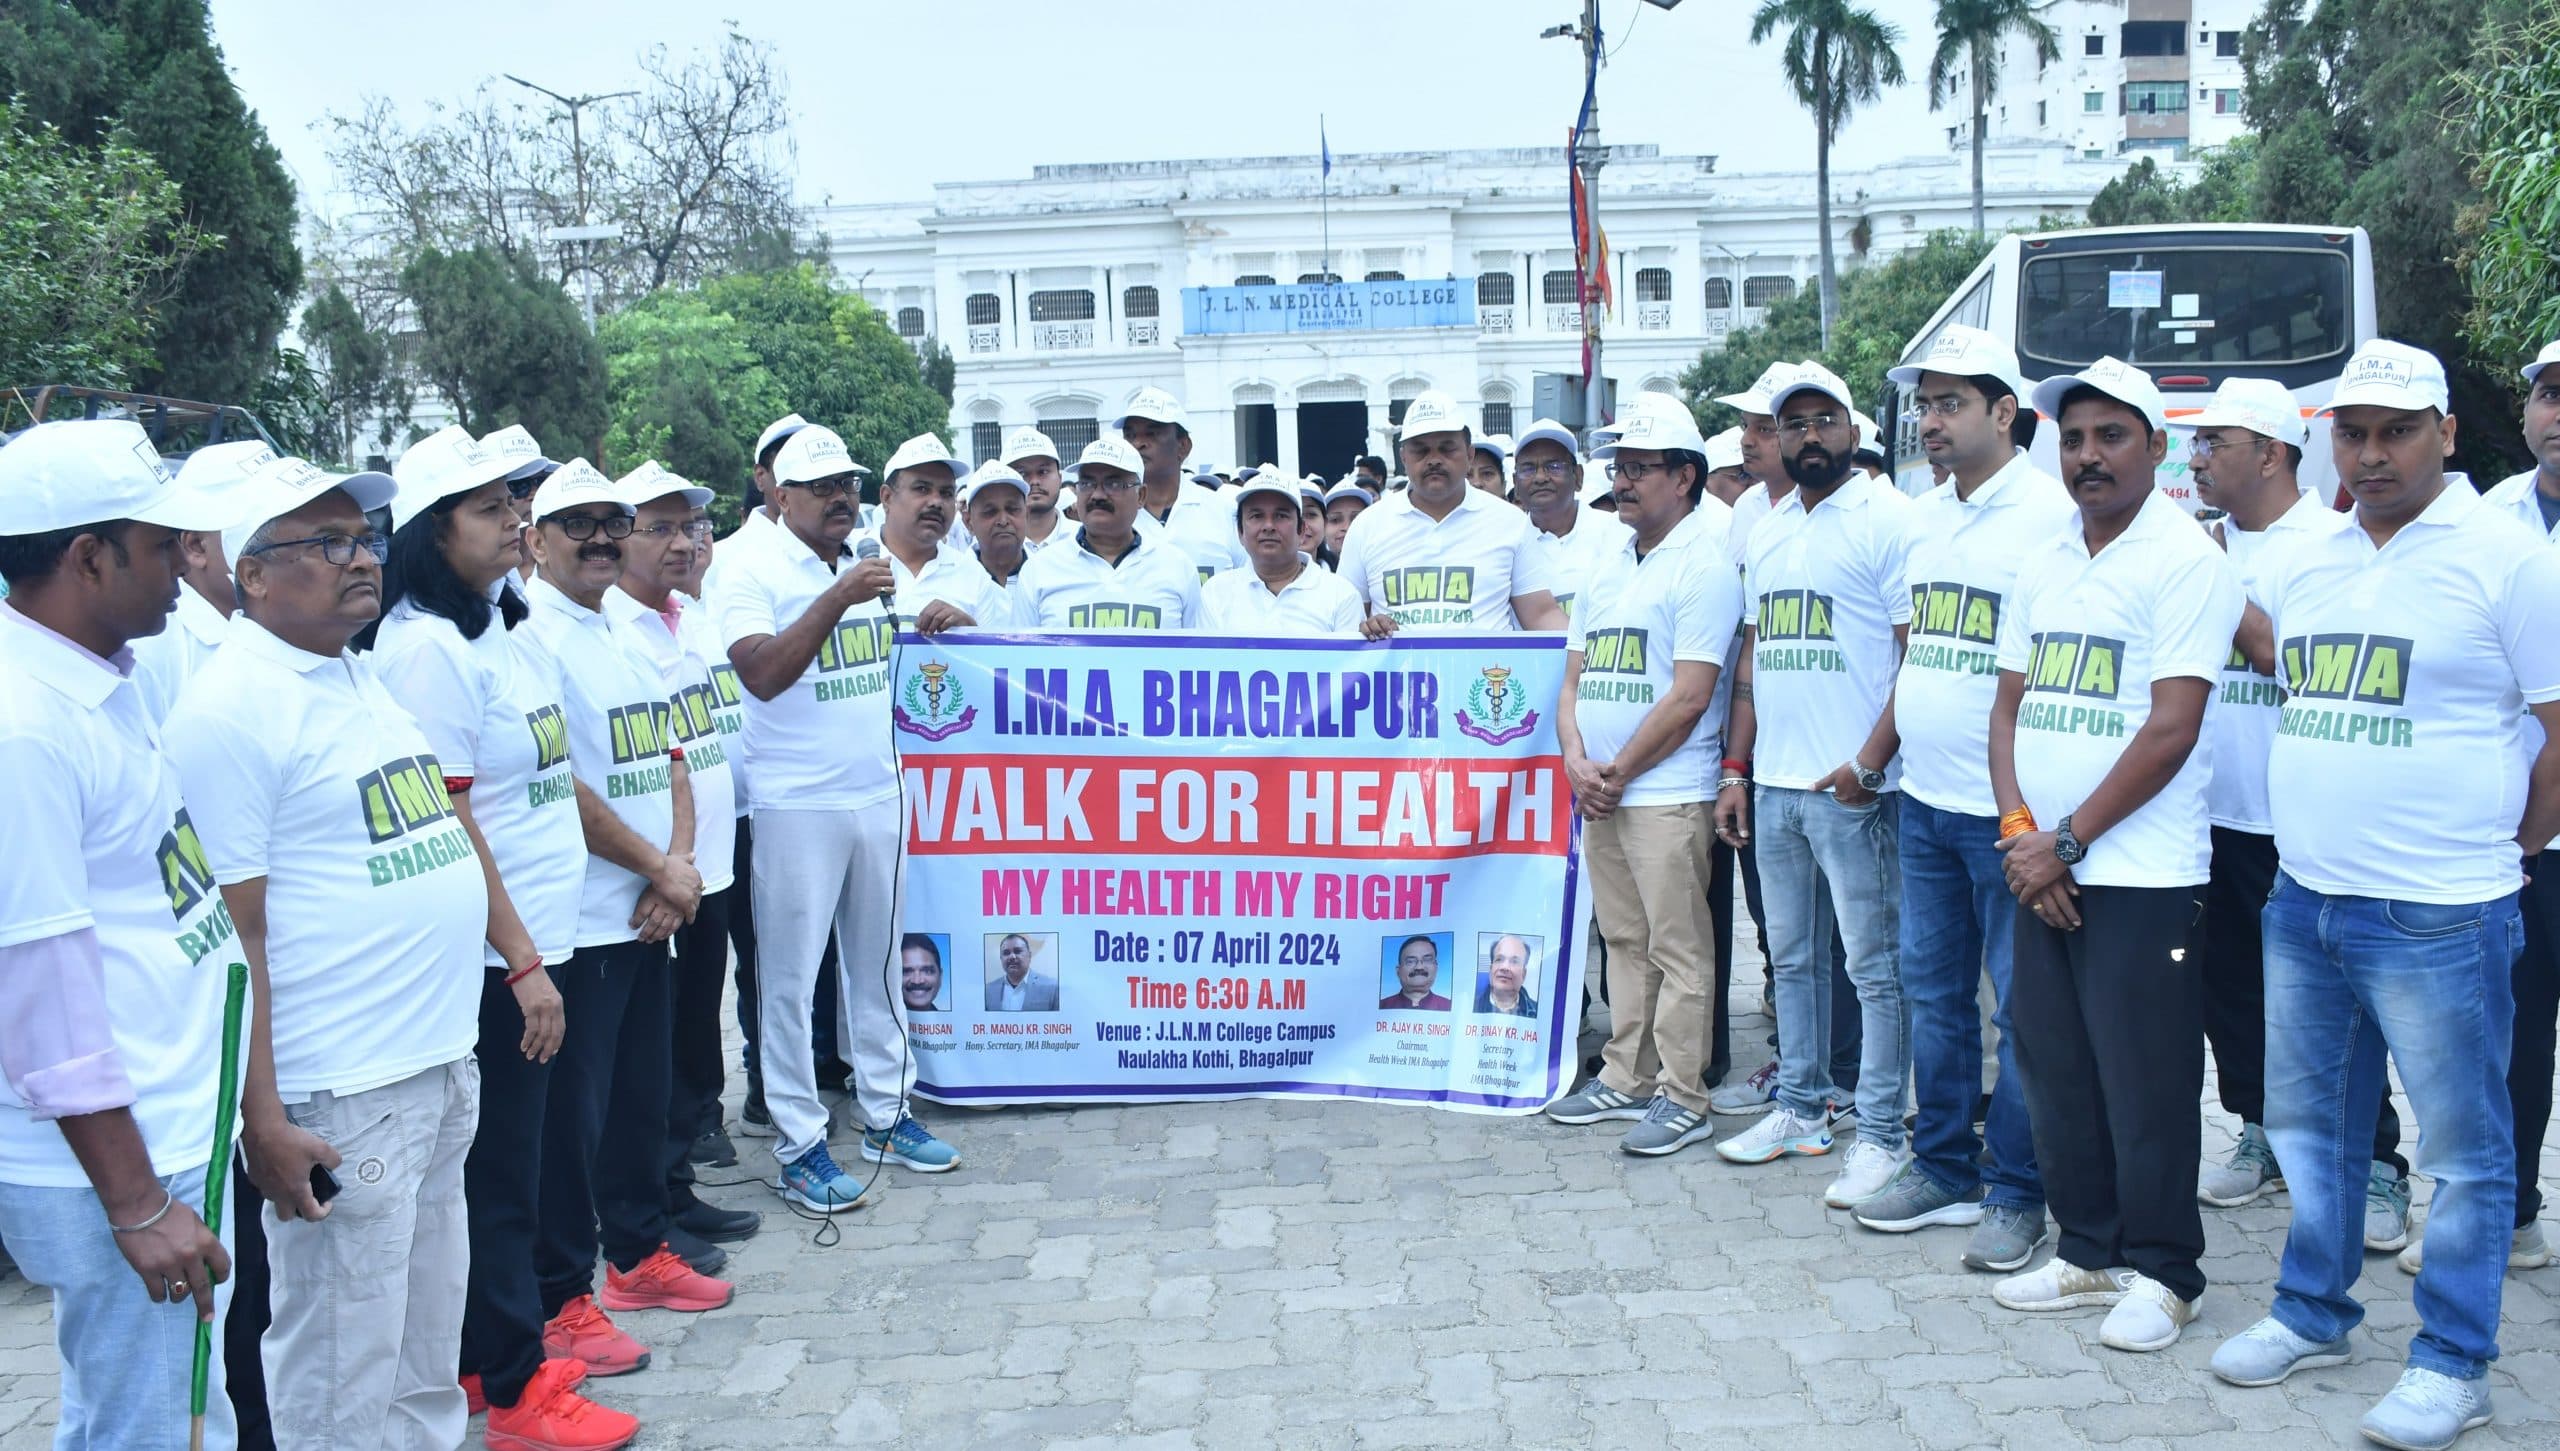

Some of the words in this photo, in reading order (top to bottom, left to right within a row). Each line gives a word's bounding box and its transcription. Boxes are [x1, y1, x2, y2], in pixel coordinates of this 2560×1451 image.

[1270, 292, 1358, 310] MEDICAL
[1371, 288, 1456, 306] COLLEGE
[1384, 569, 1472, 605] IMA
[2283, 639, 2408, 702] IMA
[994, 667, 1128, 737] I.M.A.
[1143, 669, 1439, 740] BHAGALPUR
[529, 707, 570, 768] IM
[2278, 707, 2413, 748] HAGALPUR
[902, 767, 1094, 842] WALK
[1119, 769, 1259, 843] FOR
[1288, 769, 1553, 847] HEALTH
[982, 869, 1049, 917] MY
[1062, 869, 1221, 917] HEALTH
[1234, 870, 1303, 917] MY
[1314, 872, 1451, 920] RIGHT
[1094, 929, 1149, 963] Date
[1173, 930, 1204, 964] 07
[1211, 931, 1270, 968] April
[1278, 932, 1341, 966] 2024
[1127, 976, 1187, 1009] Time
[1196, 977, 1249, 1010] 6:30
[1257, 978, 1306, 1010] A.M
[973, 1023, 989, 1035] DR.
[990, 1023, 1024, 1036] MANOJ
[1026, 1023, 1041, 1035] KR.
[1043, 1023, 1072, 1035] SINGH
[1096, 1021, 1141, 1042] Venue
[1155, 1021, 1211, 1042] J.L.N.M
[1216, 1022, 1272, 1044] College
[1277, 1022, 1336, 1042] Campus
[1376, 1021, 1389, 1033] DR.
[1391, 1021, 1411, 1034] AJAY
[1427, 1023, 1451, 1036] SINGH
[1505, 1026, 1519, 1040] KR.
[1521, 1030, 1538, 1043] JHA
[1024, 1040, 1039, 1050] IMA
[1041, 1040, 1080, 1053] Bhagalpur
[1118, 1049, 1187, 1069] Naulakha
[1192, 1049, 1234, 1070] Kothi,
[1239, 1048, 1314, 1068] Bhagalpur
[1368, 1053, 1389, 1064] Health
